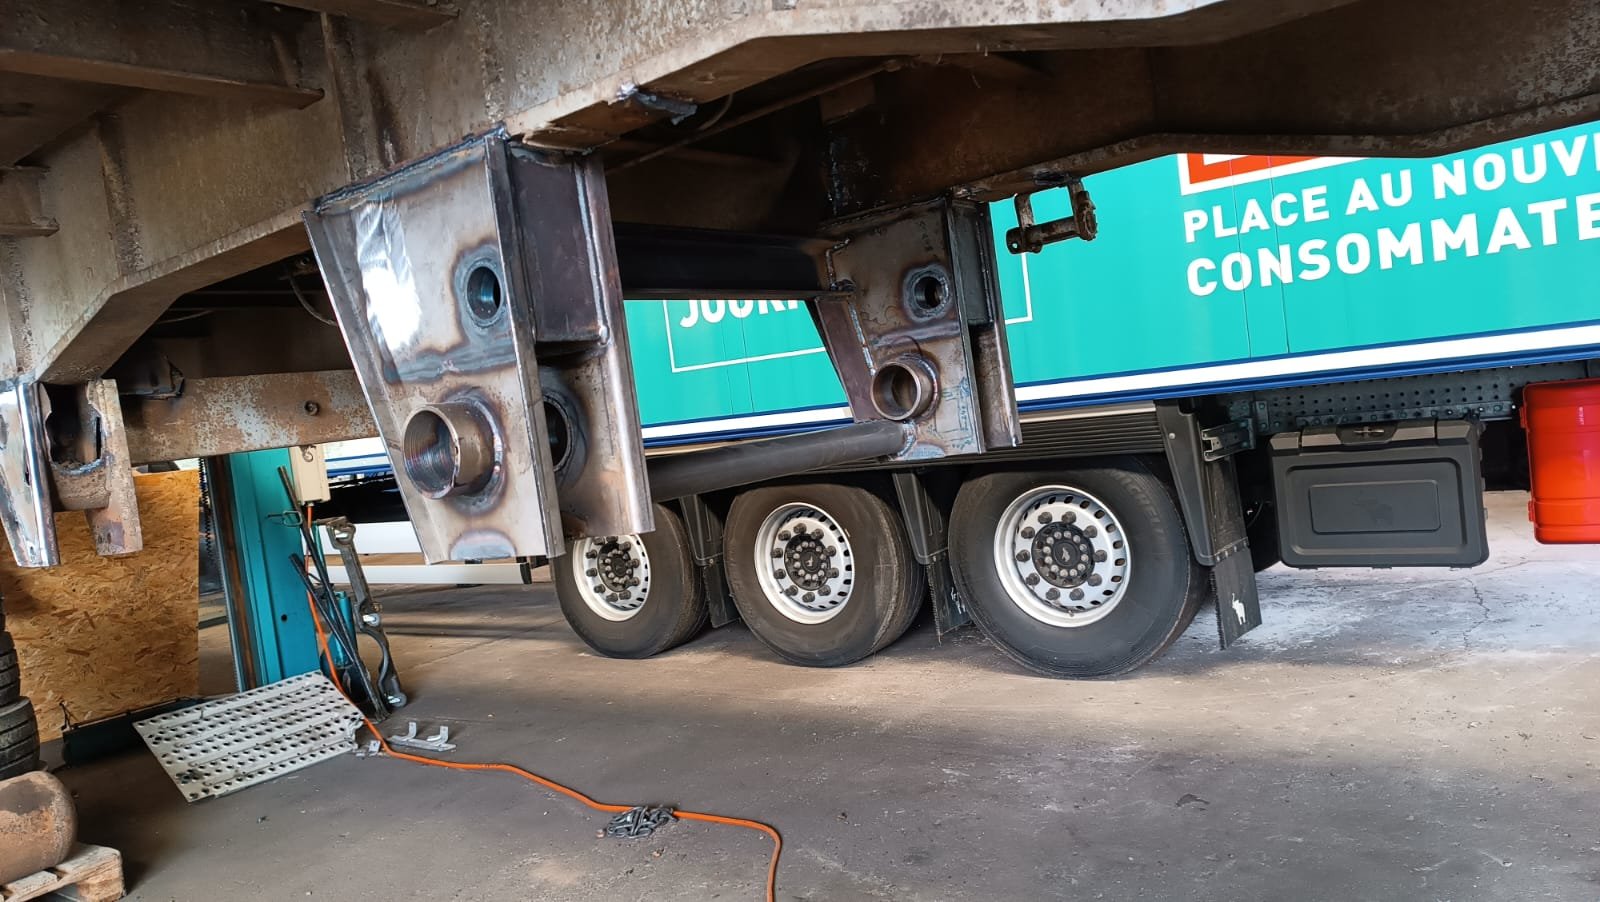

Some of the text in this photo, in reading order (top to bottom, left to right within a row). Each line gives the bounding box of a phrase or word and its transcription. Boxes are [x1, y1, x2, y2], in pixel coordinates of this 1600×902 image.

[1183, 132, 1600, 243] PLACE AU NOUV
[1186, 192, 1600, 297] CONSOMMATE
